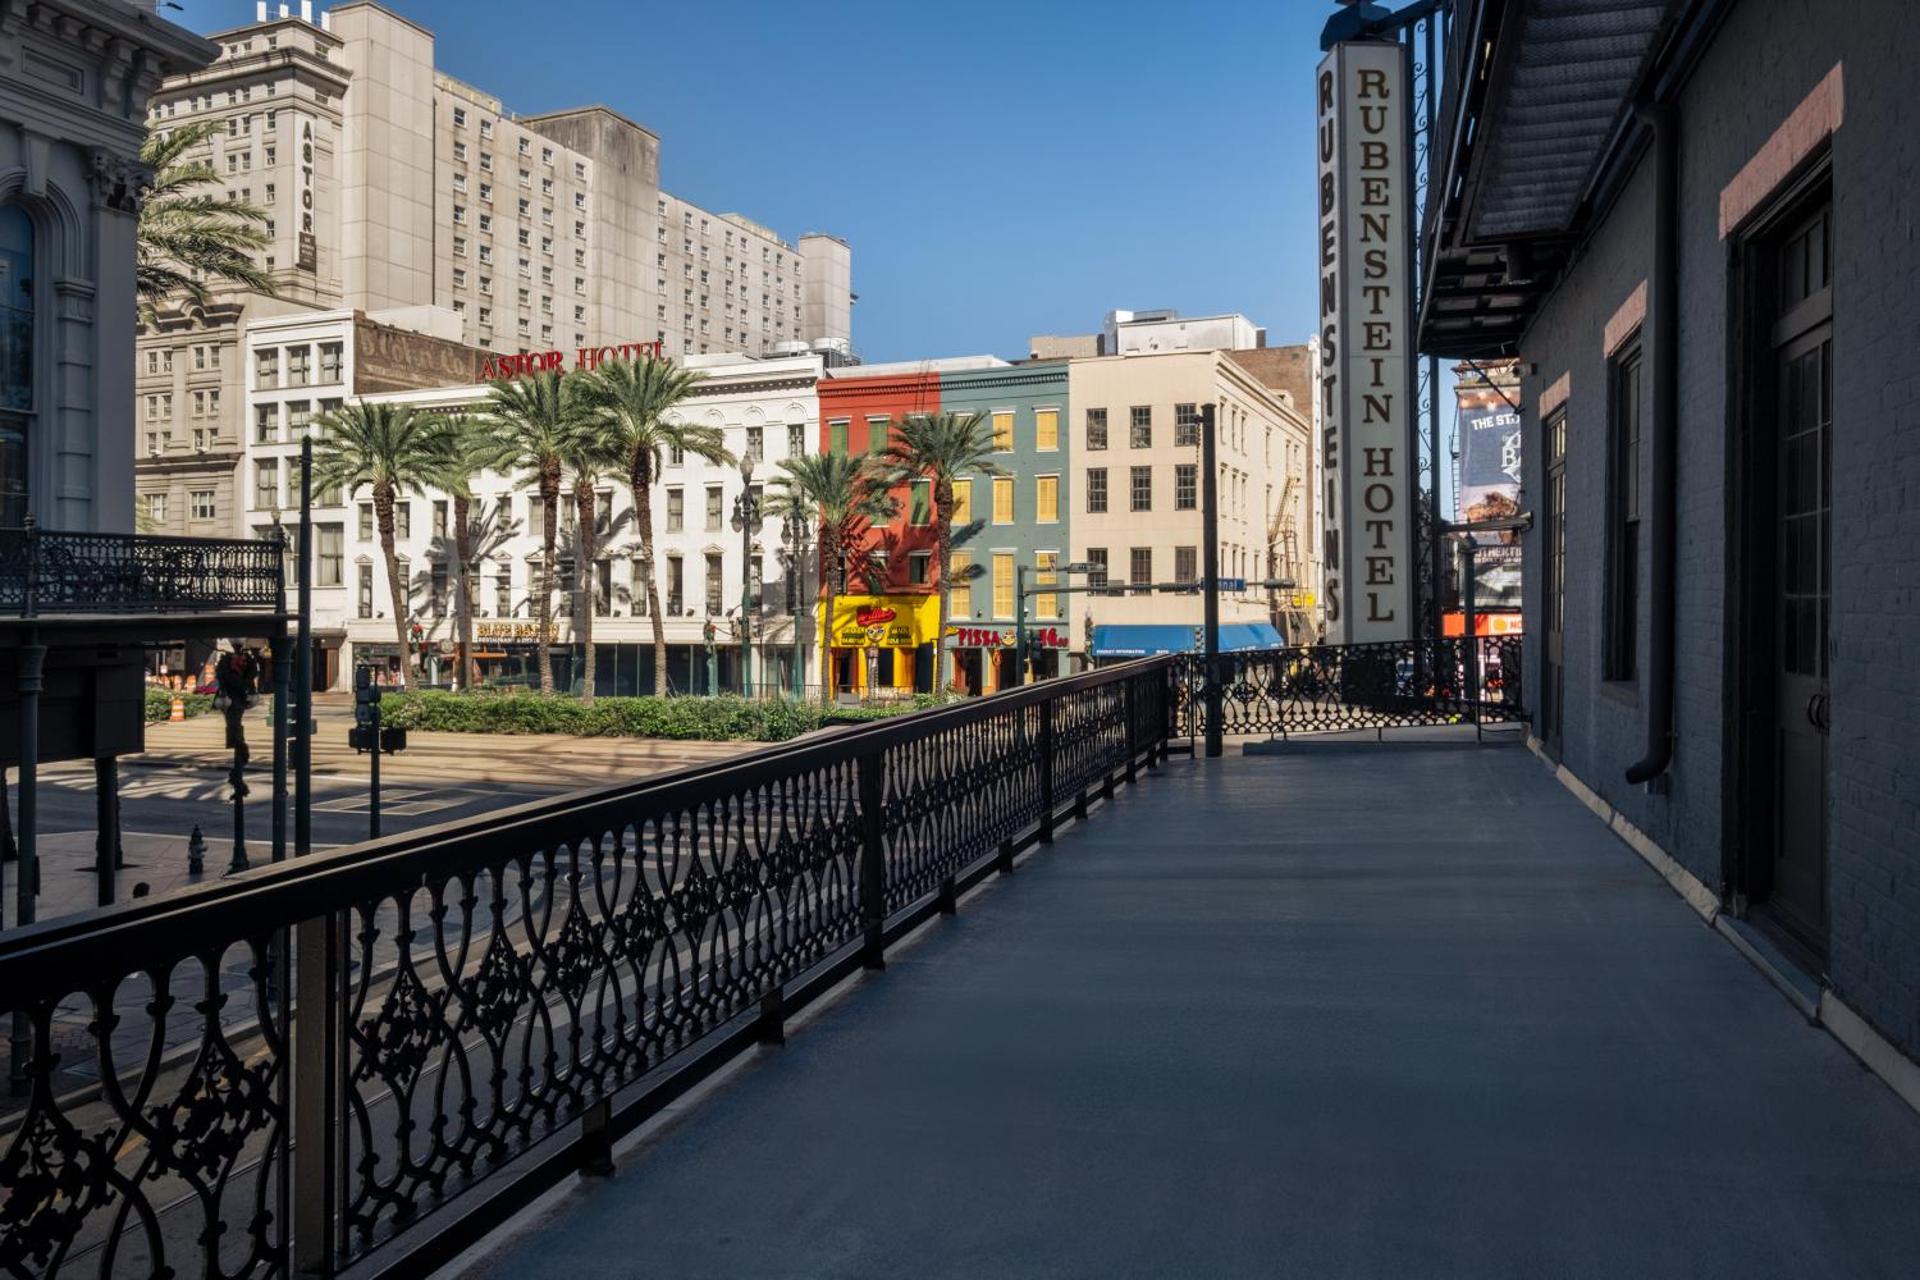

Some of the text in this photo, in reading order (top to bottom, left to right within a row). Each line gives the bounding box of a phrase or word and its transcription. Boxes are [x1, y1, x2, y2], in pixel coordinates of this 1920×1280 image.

[302, 121, 313, 233] ASTOR
[479, 350, 567, 381] ASTOR
[577, 340, 671, 370] HOTEL
[1319, 70, 1339, 623] RUBENSTEINS
[1357, 69, 1394, 623] RUBENSTEIN HOTEL
[1471, 416, 1494, 430] THE
